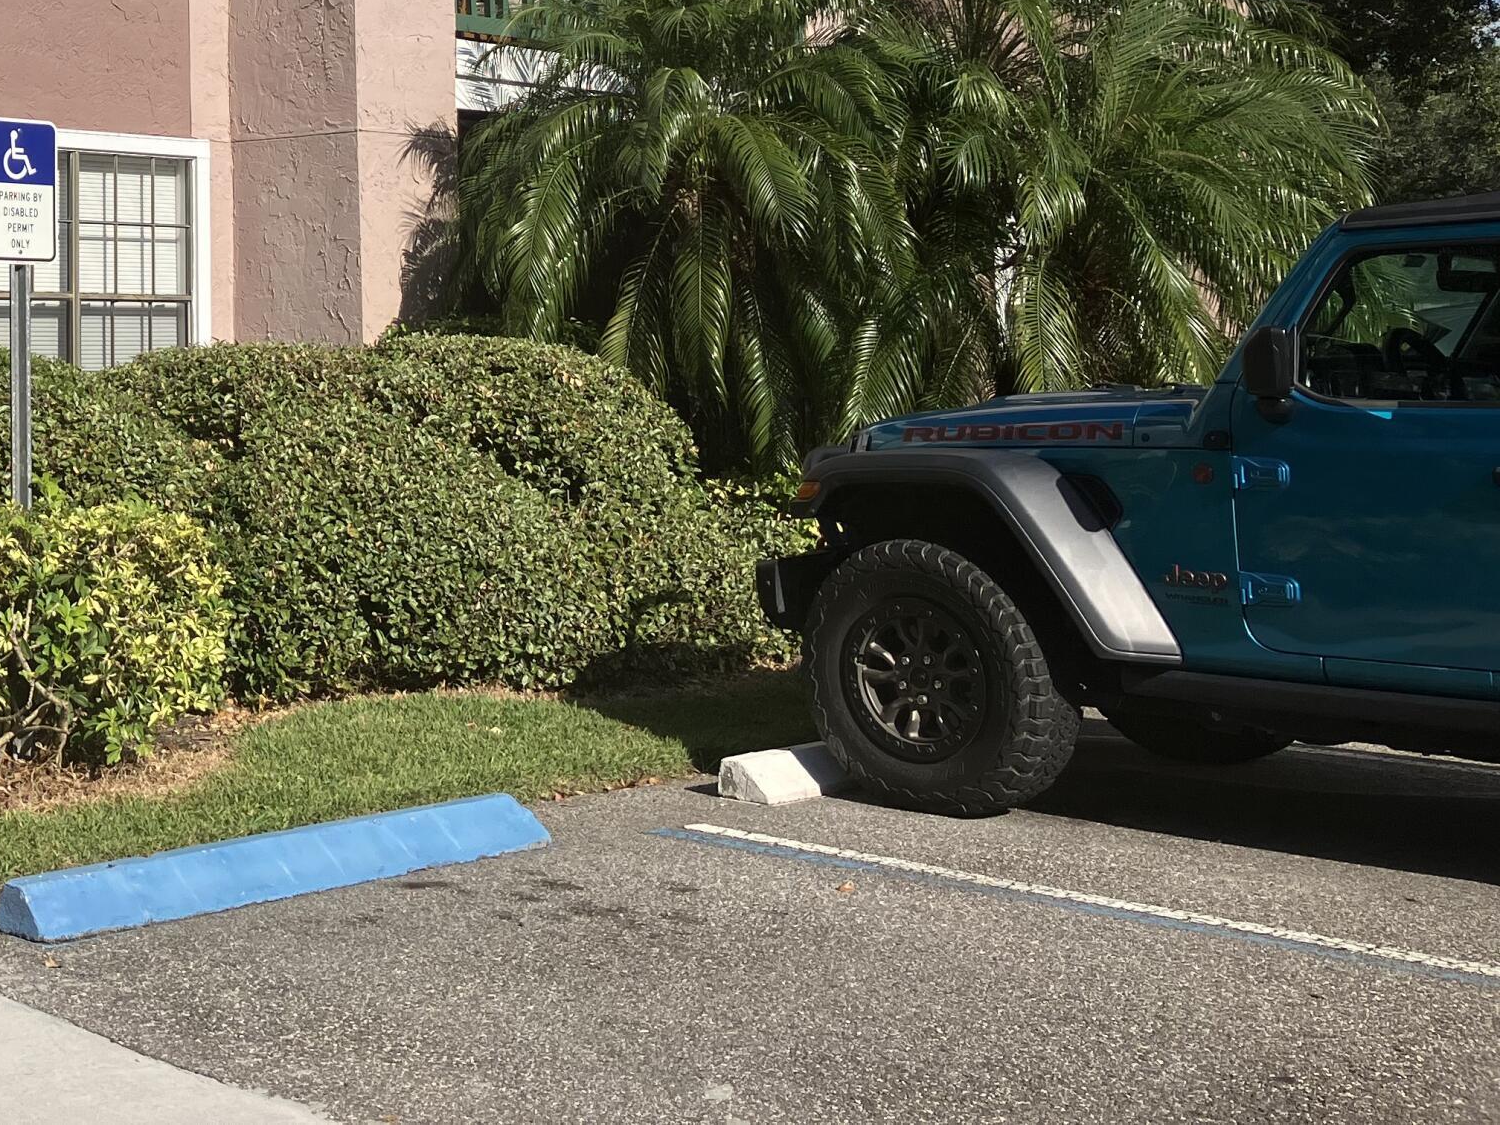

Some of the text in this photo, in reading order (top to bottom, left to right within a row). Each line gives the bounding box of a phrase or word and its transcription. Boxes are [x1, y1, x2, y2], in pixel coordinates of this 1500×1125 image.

[33, 193, 42, 202] BY
[3, 207, 38, 218] DISABLED
[8, 222, 34, 233] PERMIT
[11, 238, 30, 248] ONLY
[902, 422, 1124, 443] RUBICON
[1165, 563, 1227, 593] Jeep
